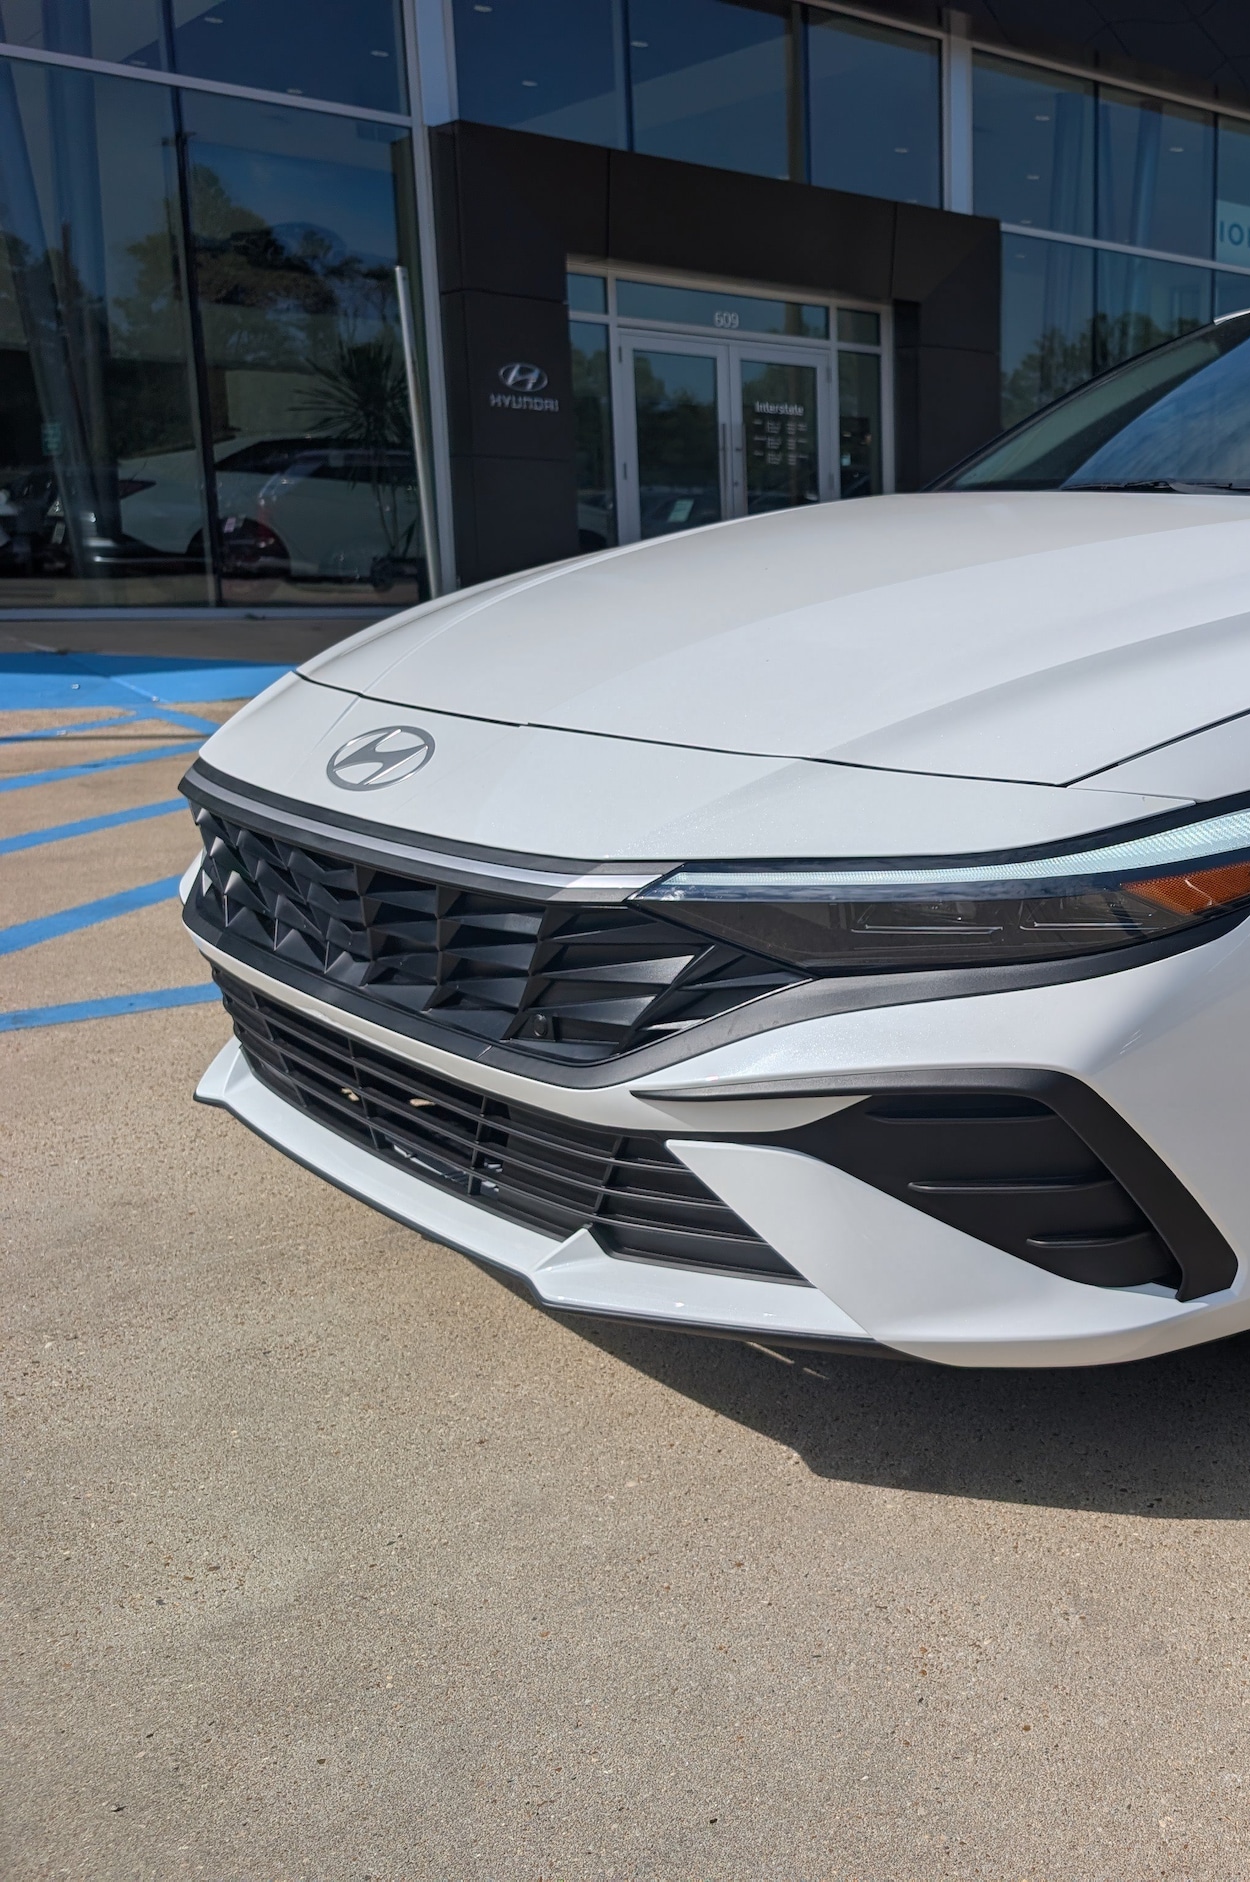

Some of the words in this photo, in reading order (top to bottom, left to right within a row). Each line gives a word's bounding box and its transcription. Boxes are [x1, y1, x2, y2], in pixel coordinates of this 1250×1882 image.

[714, 311, 740, 329] 609
[490, 393, 559, 412] HYUNDAI
[755, 401, 804, 417] Interstate
